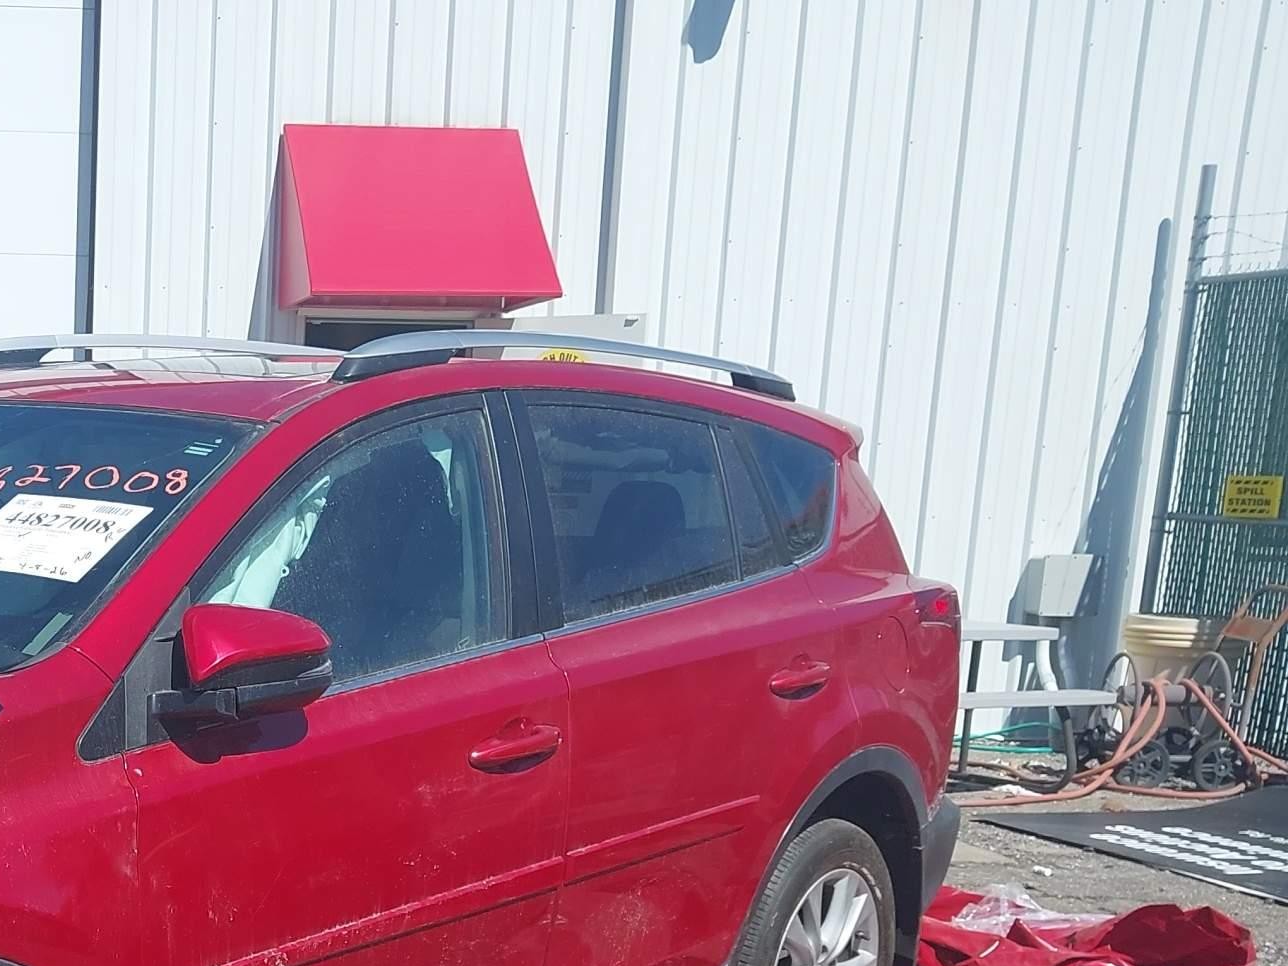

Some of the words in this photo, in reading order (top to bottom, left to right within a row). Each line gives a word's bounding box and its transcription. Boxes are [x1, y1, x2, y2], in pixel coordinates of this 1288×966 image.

[1237, 487, 1265, 495] SPILL
[1227, 498, 1272, 506] STATION
[4, 511, 116, 534] 44827008
